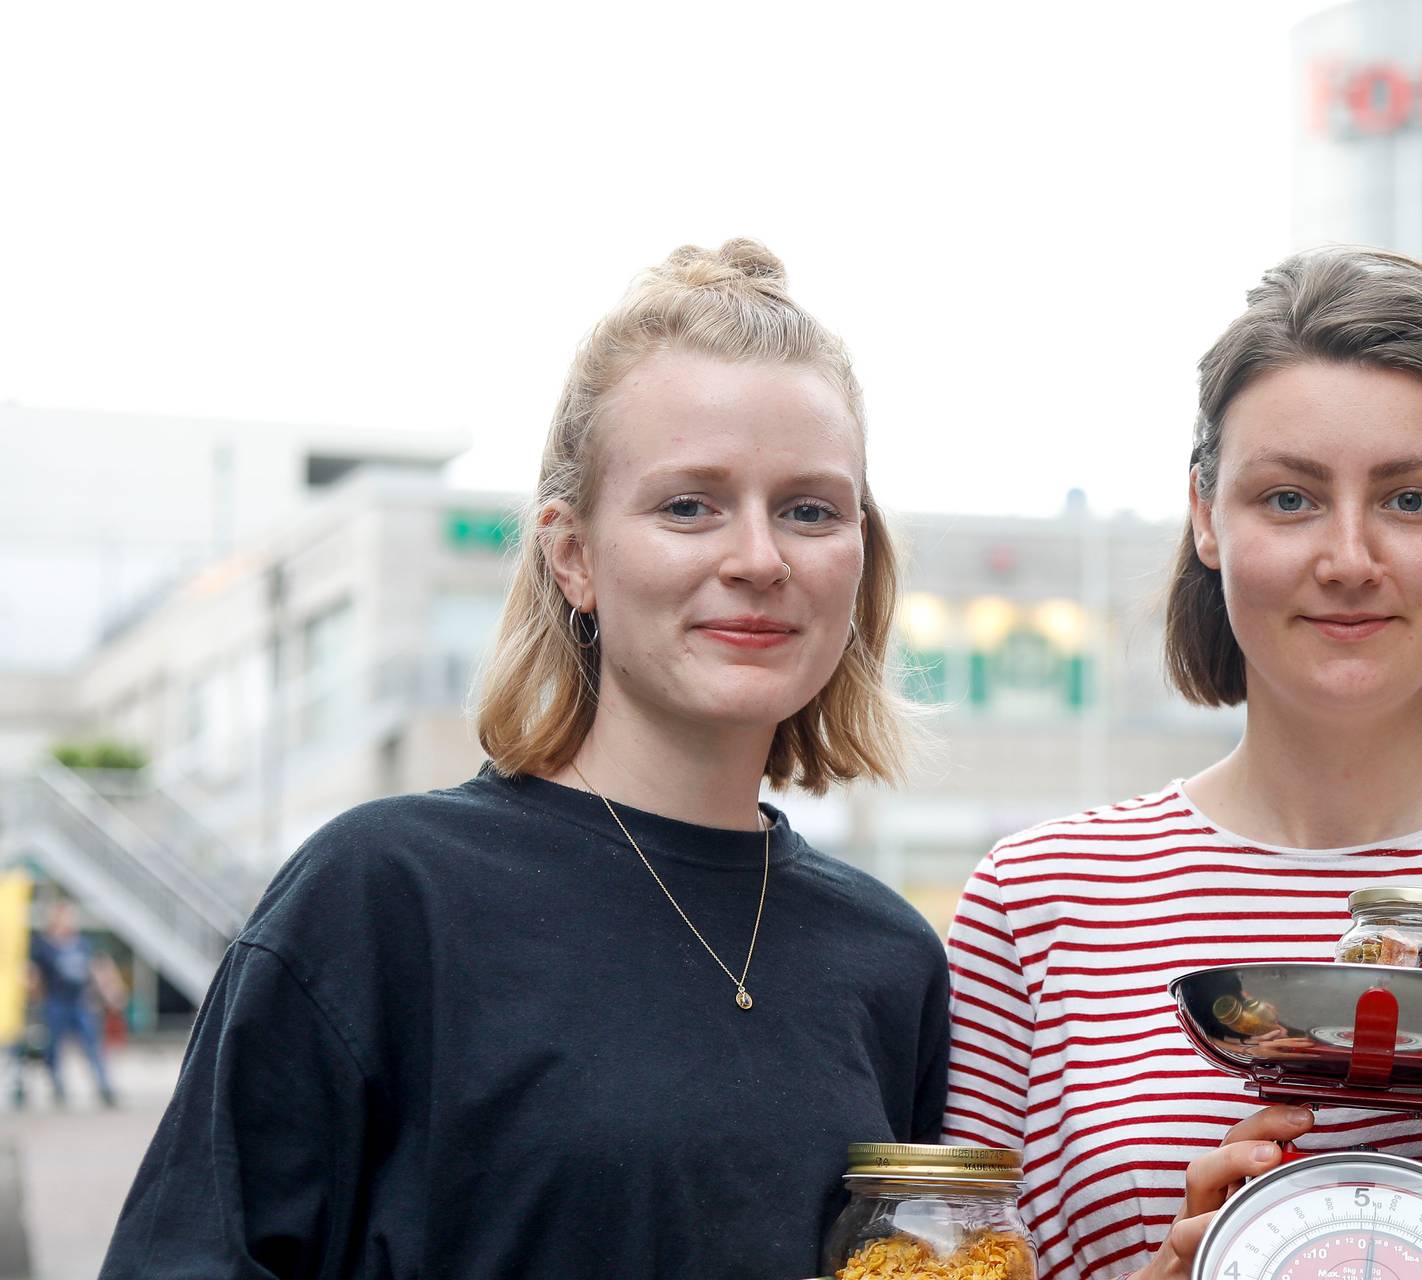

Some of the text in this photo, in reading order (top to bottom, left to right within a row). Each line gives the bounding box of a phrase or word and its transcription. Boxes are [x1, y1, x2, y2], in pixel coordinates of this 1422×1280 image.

[1354, 1187, 1370, 1207] 5
[1358, 1239, 1366, 1249] 0
[1311, 1248, 1328, 1259] 10
[1223, 1260, 1241, 1280] 4
